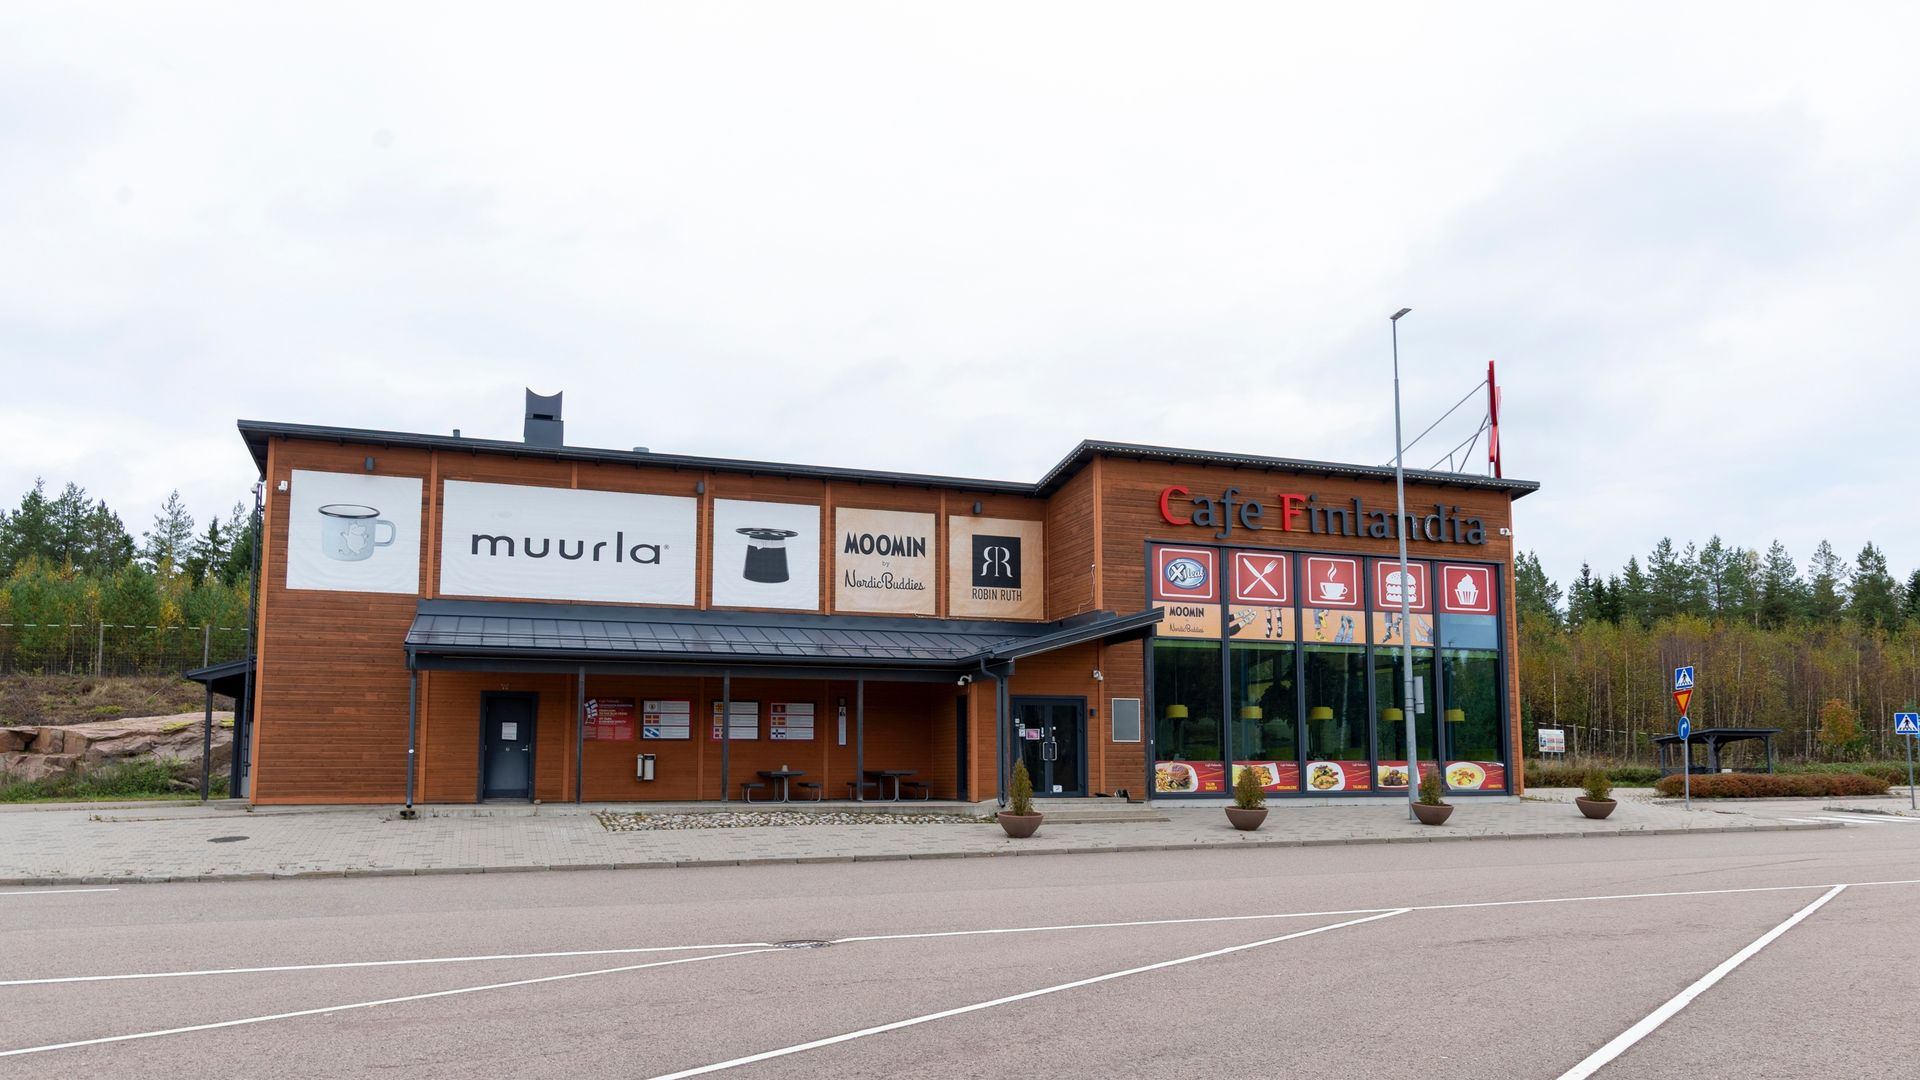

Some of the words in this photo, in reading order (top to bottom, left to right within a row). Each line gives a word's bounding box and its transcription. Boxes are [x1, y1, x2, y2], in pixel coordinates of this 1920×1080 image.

[1159, 486, 1264, 539] Cafe
[1279, 492, 1487, 545] Finlandia
[471, 531, 661, 564] muurla
[844, 531, 926, 558] MOOMIN
[972, 588, 998, 600] ROBIN
[1000, 589, 1022, 602] RUTH
[1169, 606, 1204, 617] MOOMIN
